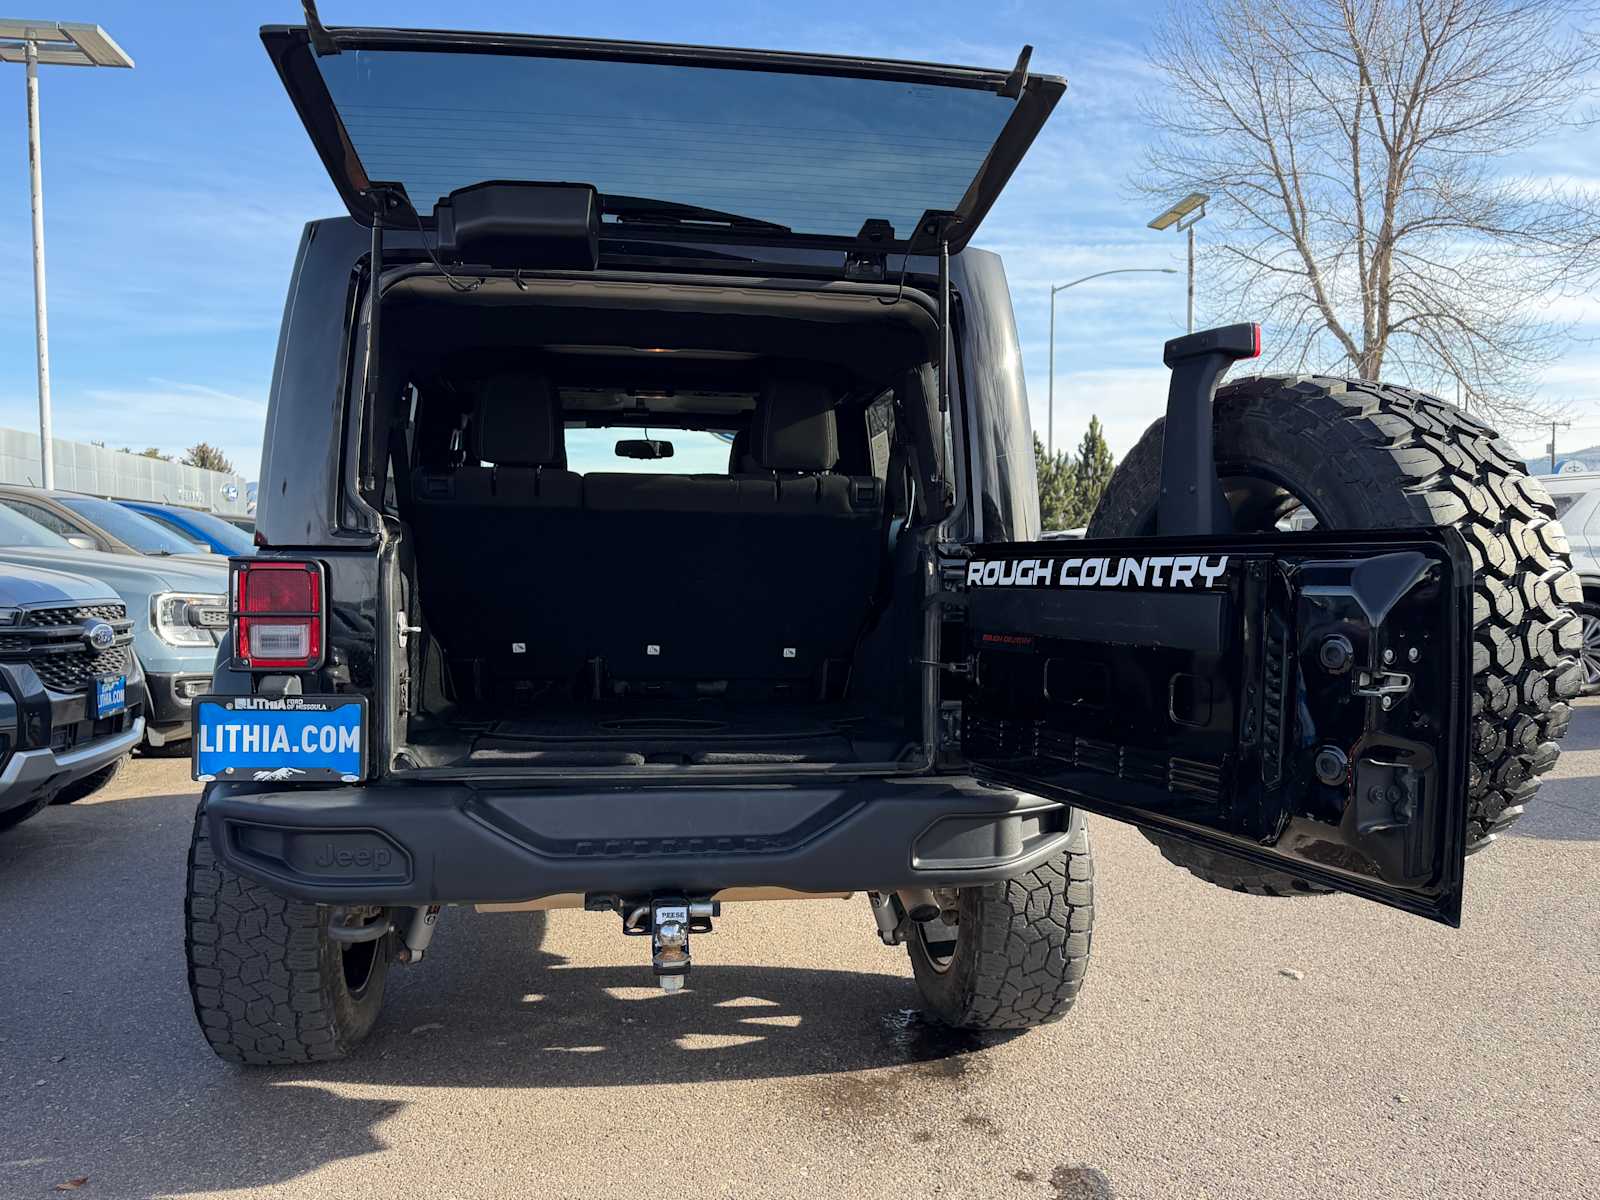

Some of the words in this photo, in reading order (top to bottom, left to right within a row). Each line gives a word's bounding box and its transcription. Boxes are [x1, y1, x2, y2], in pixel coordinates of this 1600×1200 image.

[966, 559, 1055, 586] ROUGH
[1059, 555, 1229, 588] COUNTRY
[247, 697, 287, 710] LITHIA
[200, 724, 360, 753] LITHIA.COM
[315, 844, 392, 871] Jeep
